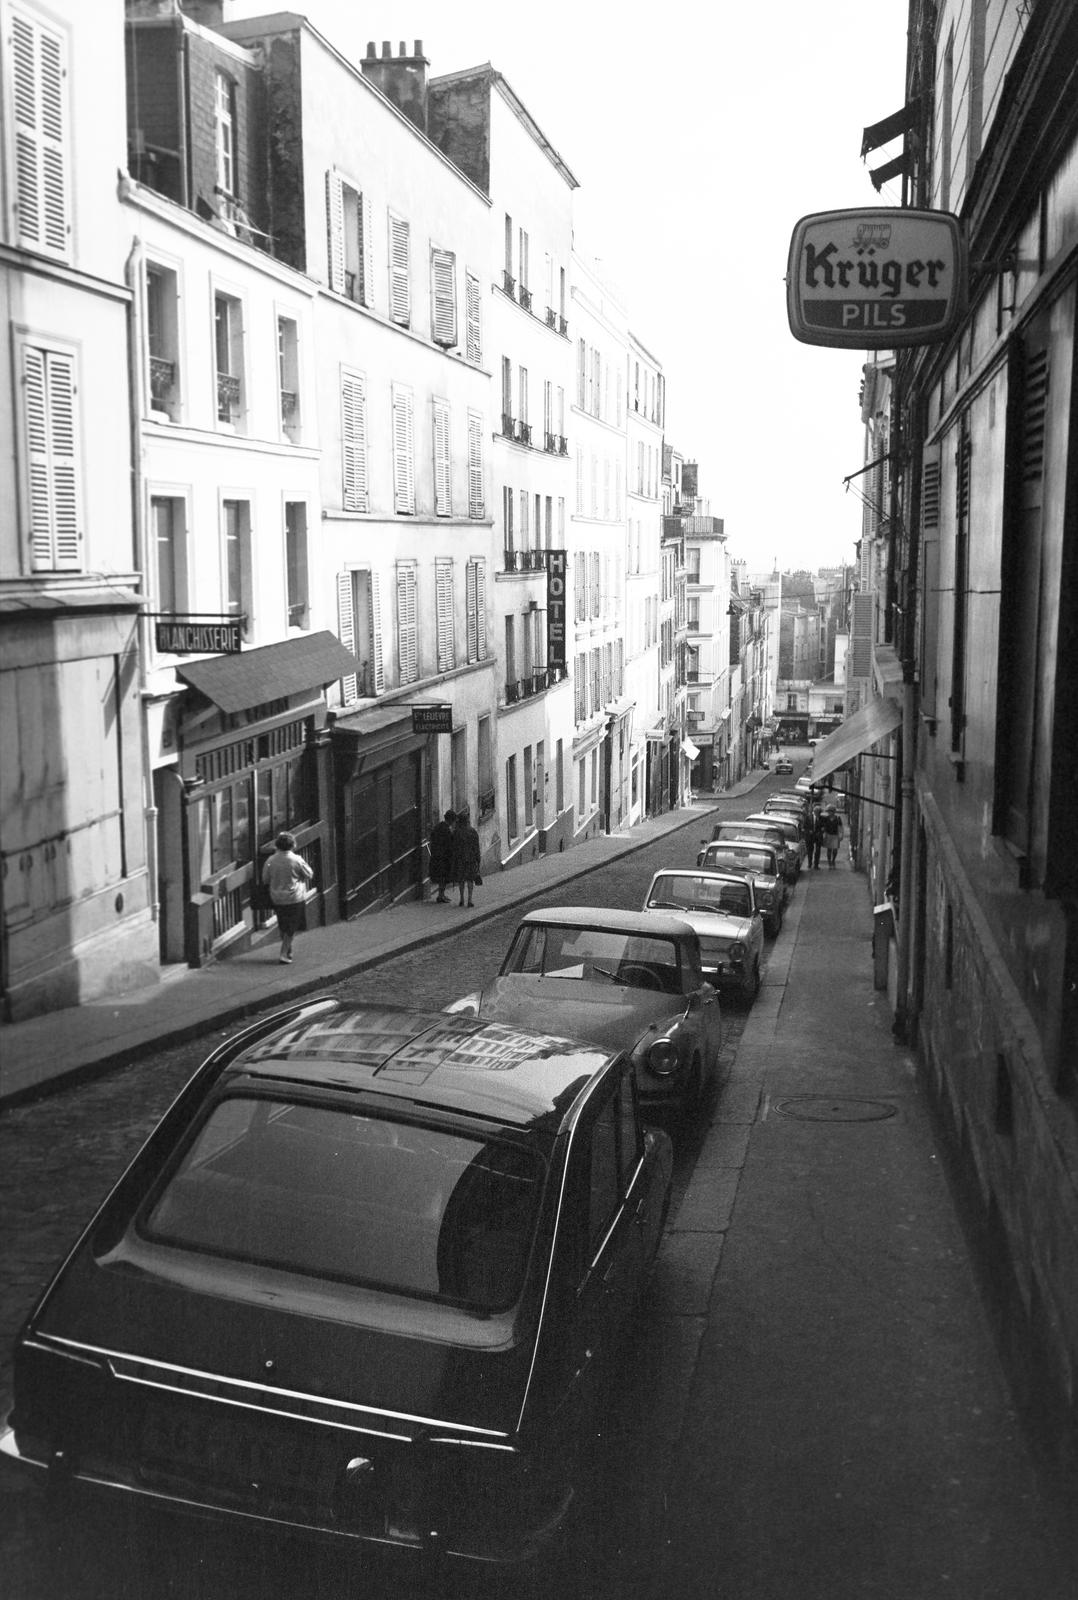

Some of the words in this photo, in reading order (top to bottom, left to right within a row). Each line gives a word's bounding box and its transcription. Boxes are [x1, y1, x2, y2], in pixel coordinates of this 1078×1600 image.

[805, 242, 945, 298] Krüger
[842, 303, 906, 326] PILS
[549, 554, 564, 664] HOTEL
[159, 626, 239, 651] BLANCHISSERIE
